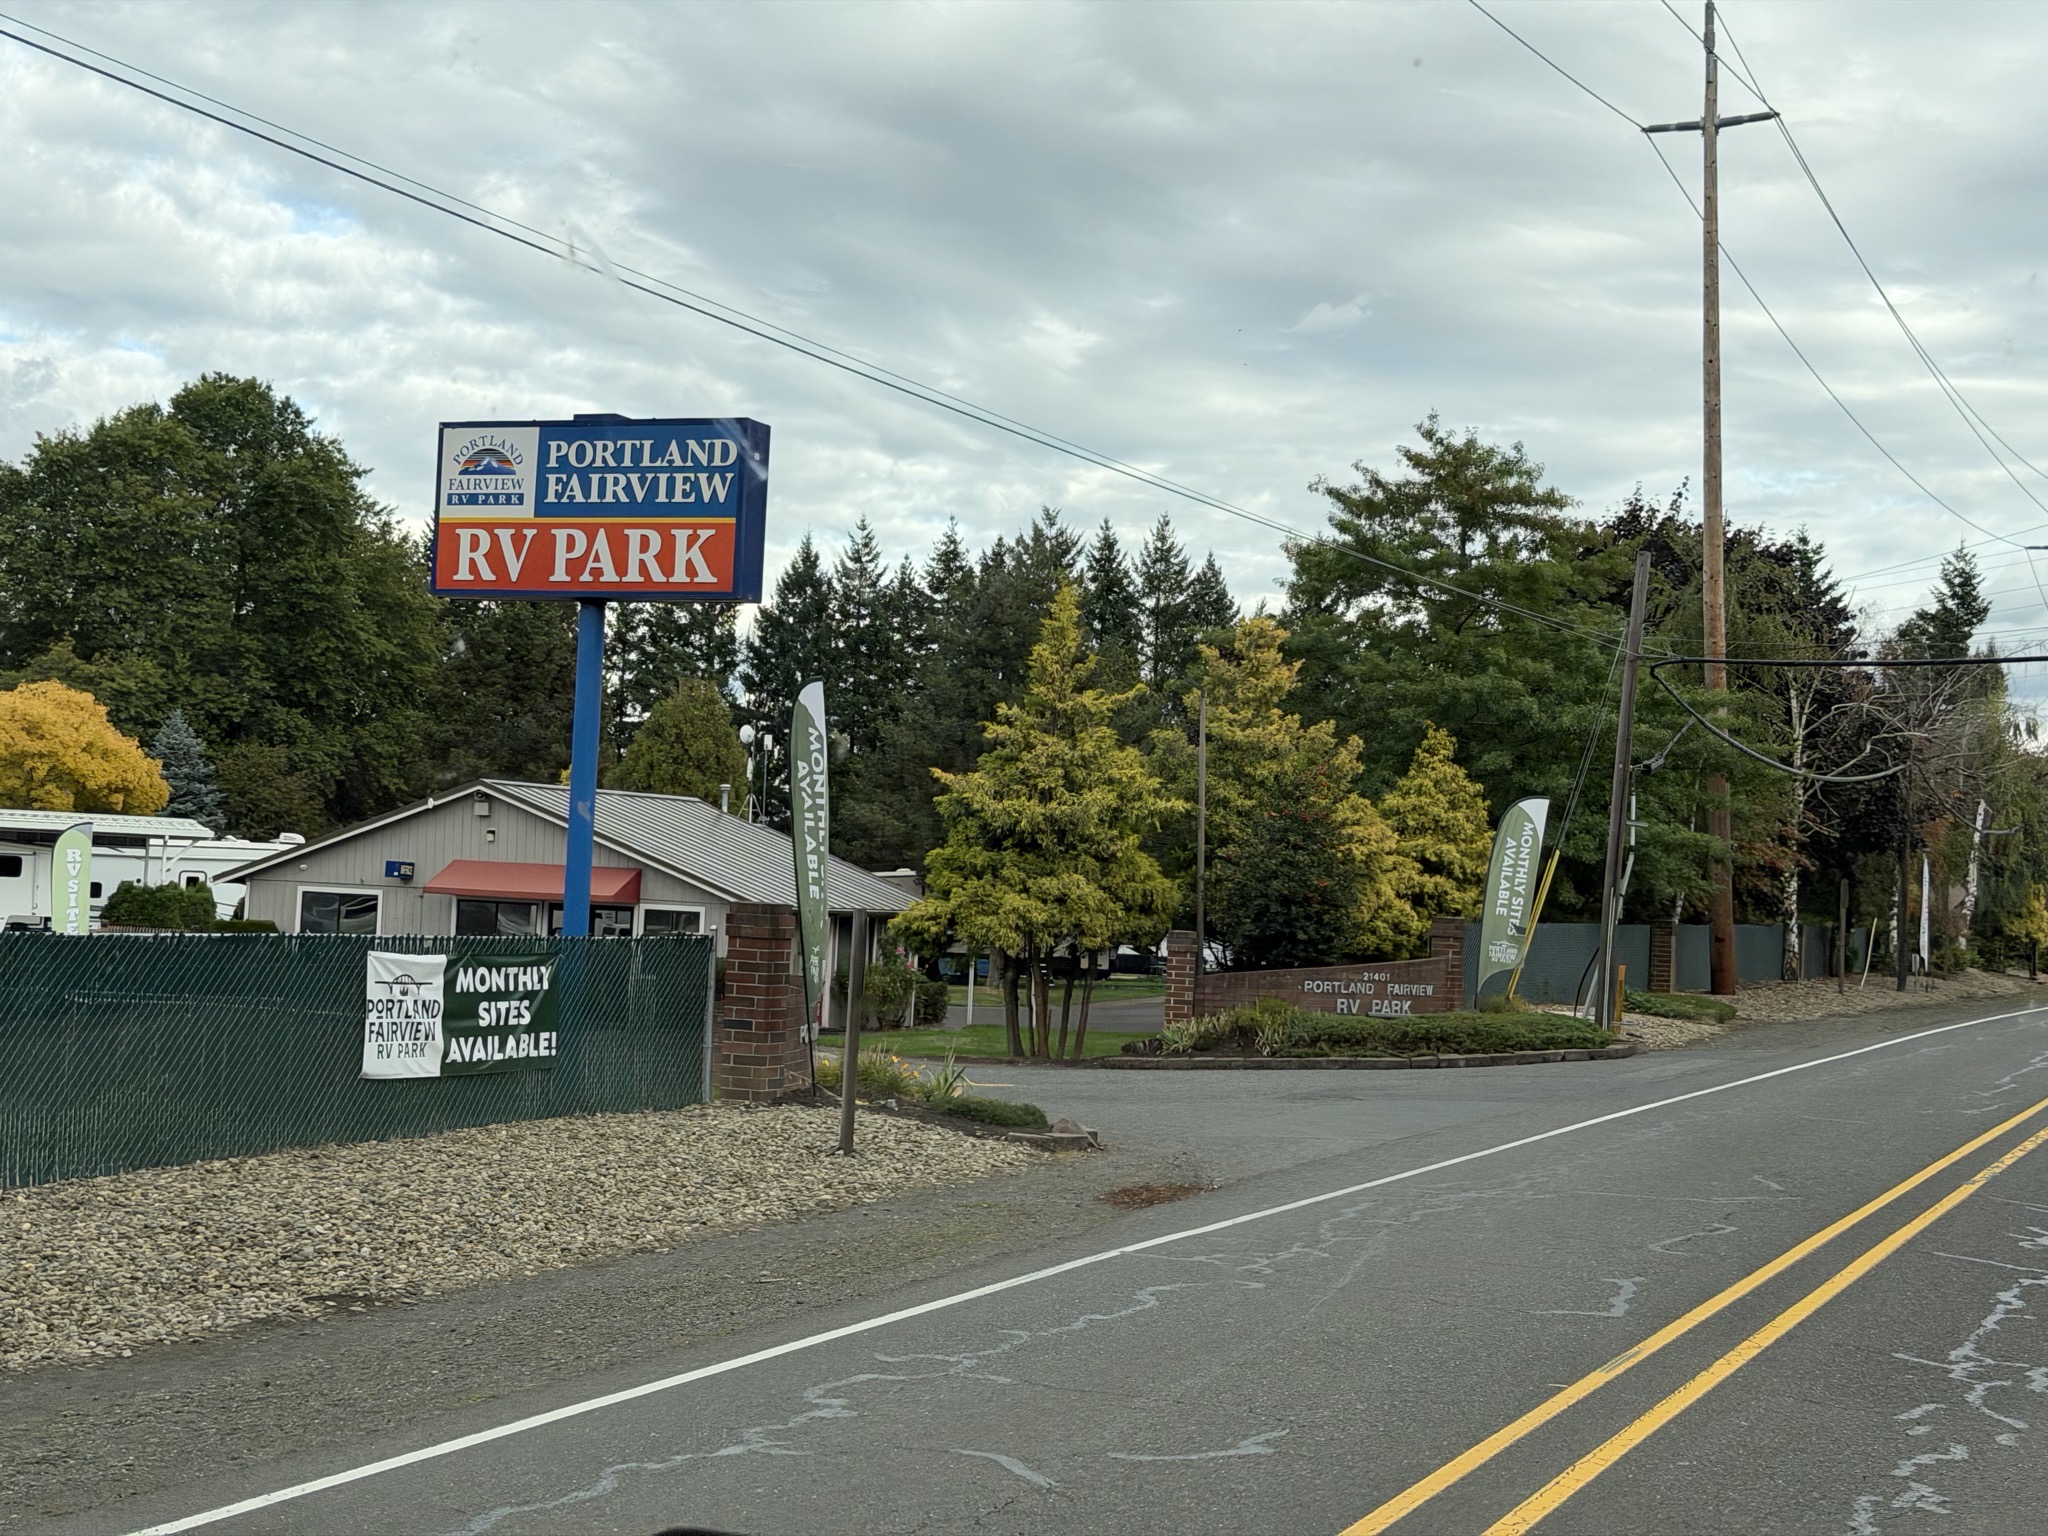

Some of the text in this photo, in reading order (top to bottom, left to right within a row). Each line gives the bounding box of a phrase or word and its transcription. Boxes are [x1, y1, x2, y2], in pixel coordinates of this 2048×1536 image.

[452, 435, 524, 466] PORTLAND
[545, 439, 738, 468] PORTLAND
[448, 478, 525, 491] FAIRVIEW
[544, 472, 735, 504] FAIRVIEW
[451, 495, 520, 504] RV PARK
[453, 527, 718, 583] RV PARK
[797, 759, 820, 900] AVAILABLE
[1514, 821, 1535, 895] MONTHLY
[1495, 837, 1517, 917] AVAILABLE
[455, 965, 552, 993] MONTHLY
[1304, 980, 1433, 996] PORTLAND FAIRVIEW
[1363, 972, 1390, 981] 21401
[367, 998, 441, 1020] PORTLAND
[478, 1000, 531, 1027] SITES
[1336, 999, 1412, 1014] RV PARK
[368, 1021, 436, 1043] FAIRVIEW
[377, 1042, 427, 1059] RV PARK
[445, 1031, 557, 1063] AVAILABLE!
